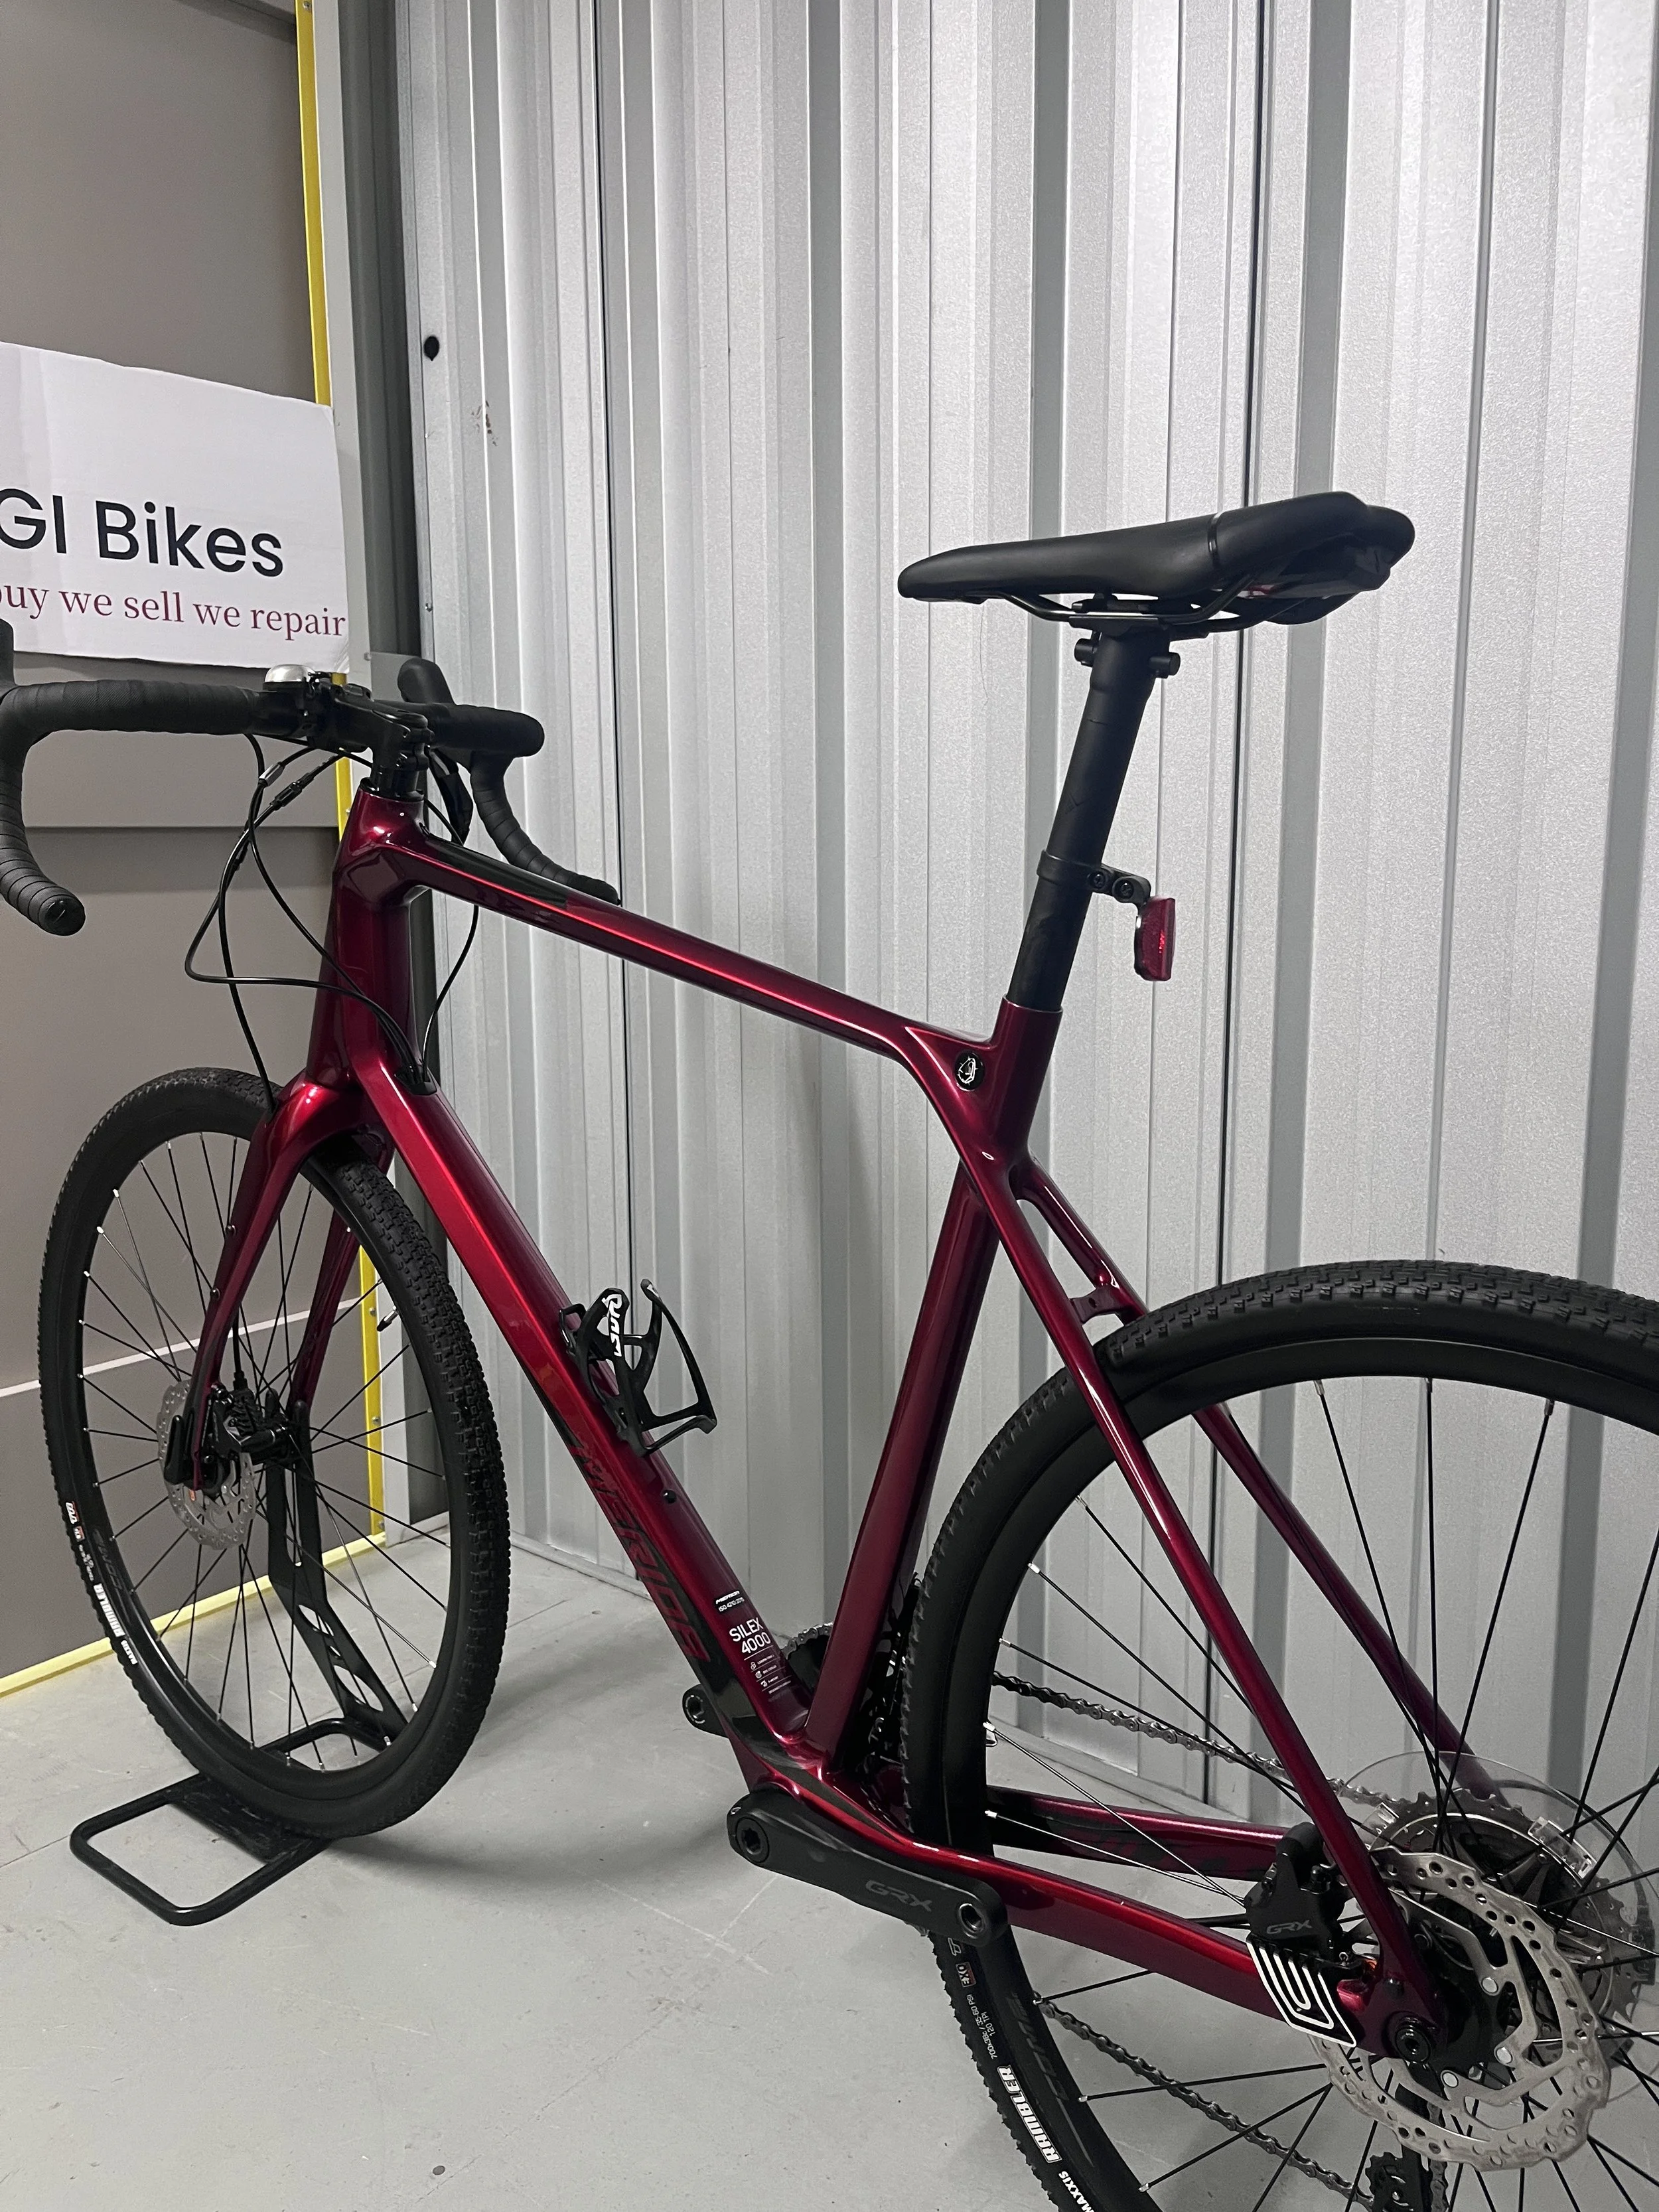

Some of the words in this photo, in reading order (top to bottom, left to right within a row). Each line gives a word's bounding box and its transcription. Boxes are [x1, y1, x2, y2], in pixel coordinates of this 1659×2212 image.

[96, 500, 283, 577] Bikes
[0, 585, 49, 619] uy
[58, 591, 113, 616] we
[124, 591, 184, 623] sell
[193, 604, 240, 628] we
[251, 608, 346, 641] repair
[572, 1444, 711, 1662] MERIDA
[729, 1617, 764, 1642] SILEX
[741, 1632, 771, 1653] 4000
[865, 1880, 933, 1913] GRX
[1266, 1919, 1313, 1935] GRX
[957, 1964, 970, 1986] EXO
[966, 1994, 975, 2005] PSI
[981, 2012, 990, 2023] TPI
[985, 2023, 996, 2037] 120
[997, 2065, 1062, 2163] RAMBLER
[1058, 2170, 1095, 2212] MAXXIS
